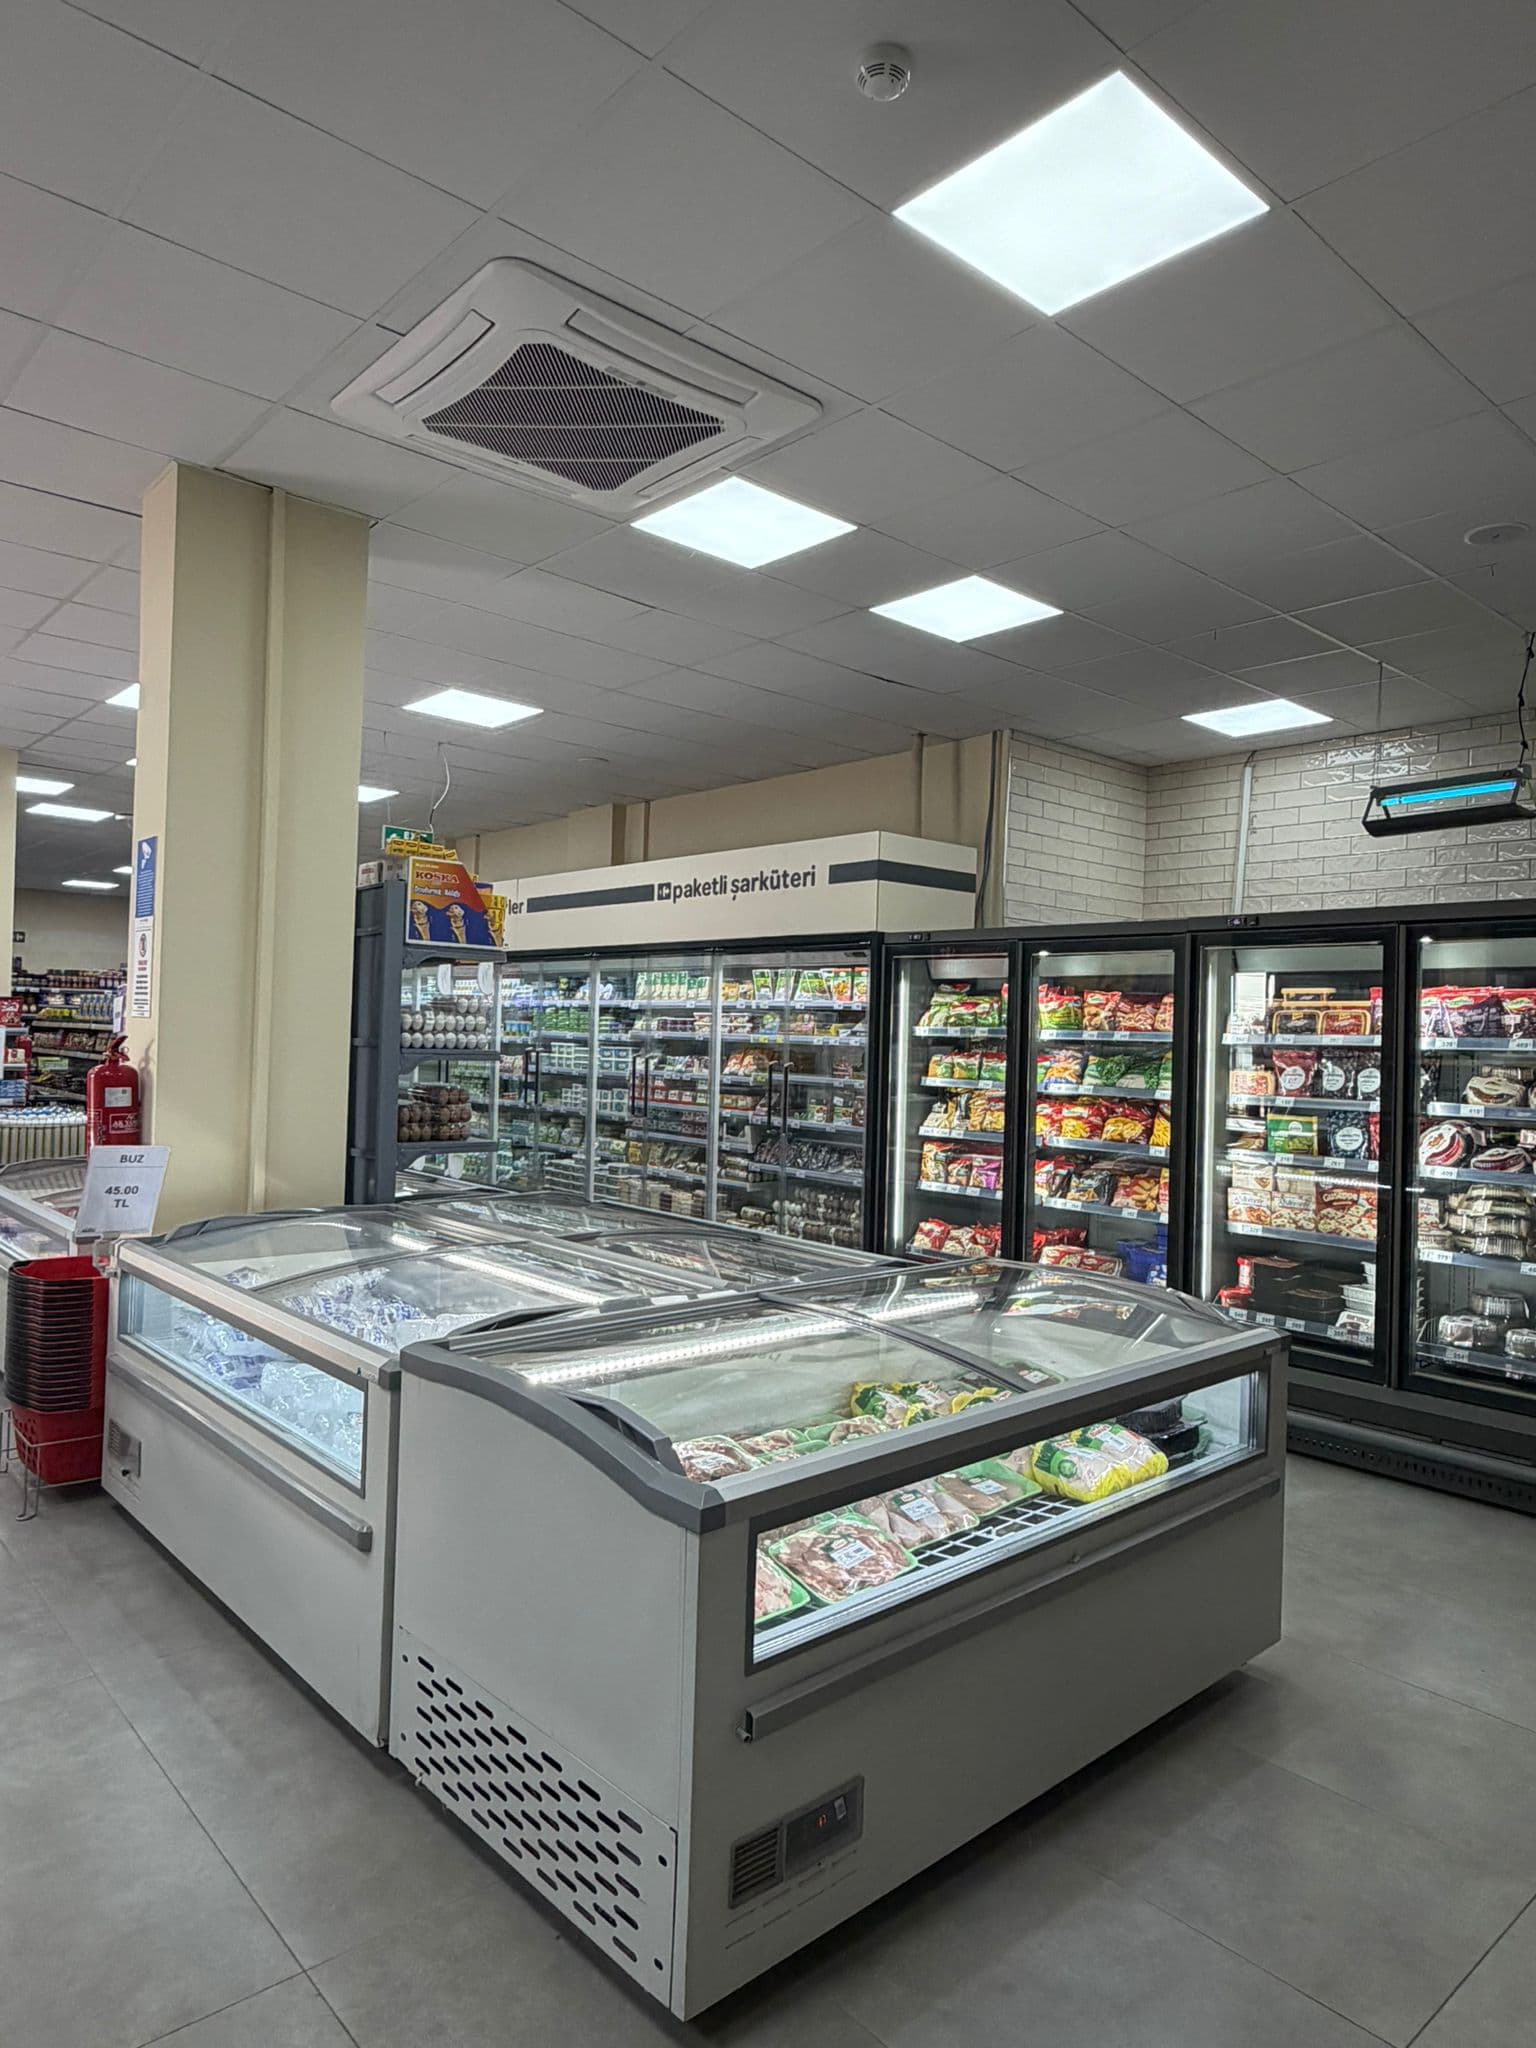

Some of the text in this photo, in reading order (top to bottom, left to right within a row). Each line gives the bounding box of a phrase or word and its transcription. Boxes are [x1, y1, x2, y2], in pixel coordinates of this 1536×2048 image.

[415, 871, 459, 883] KOSKA
[673, 864, 816, 904] paketli şarküteri
[505, 899, 524, 915] ler
[119, 1154, 145, 1164] BUZ
[104, 1185, 139, 1195] 45.00
[114, 1199, 130, 1208] TL
